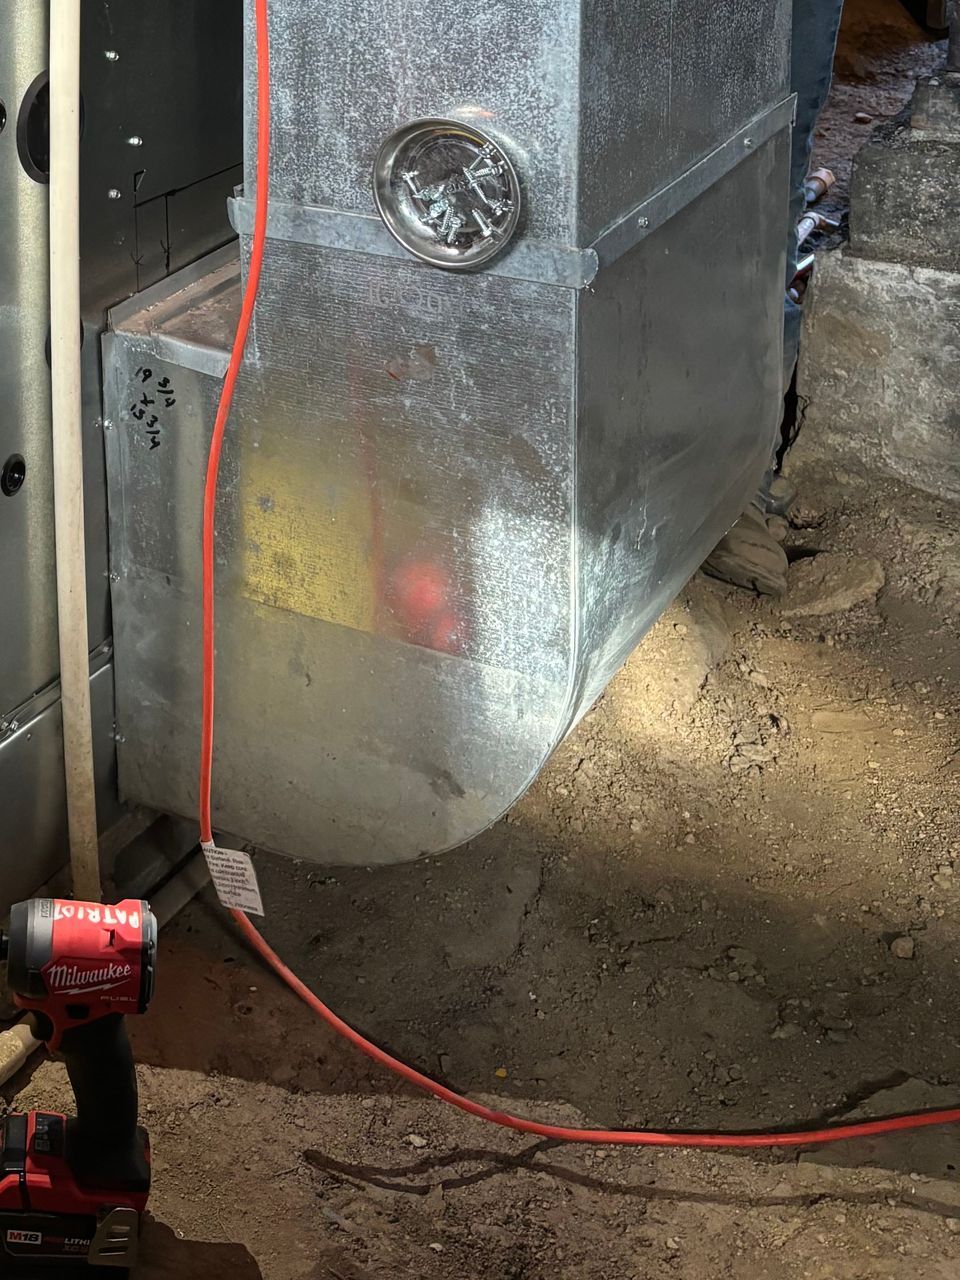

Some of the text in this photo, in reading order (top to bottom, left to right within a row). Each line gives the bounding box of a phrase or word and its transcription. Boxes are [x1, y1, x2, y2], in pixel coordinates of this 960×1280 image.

[53, 903, 140, 929] PATRIOT
[47, 963, 131, 987] Milwaukee
[8, 1231, 40, 1243] M18
